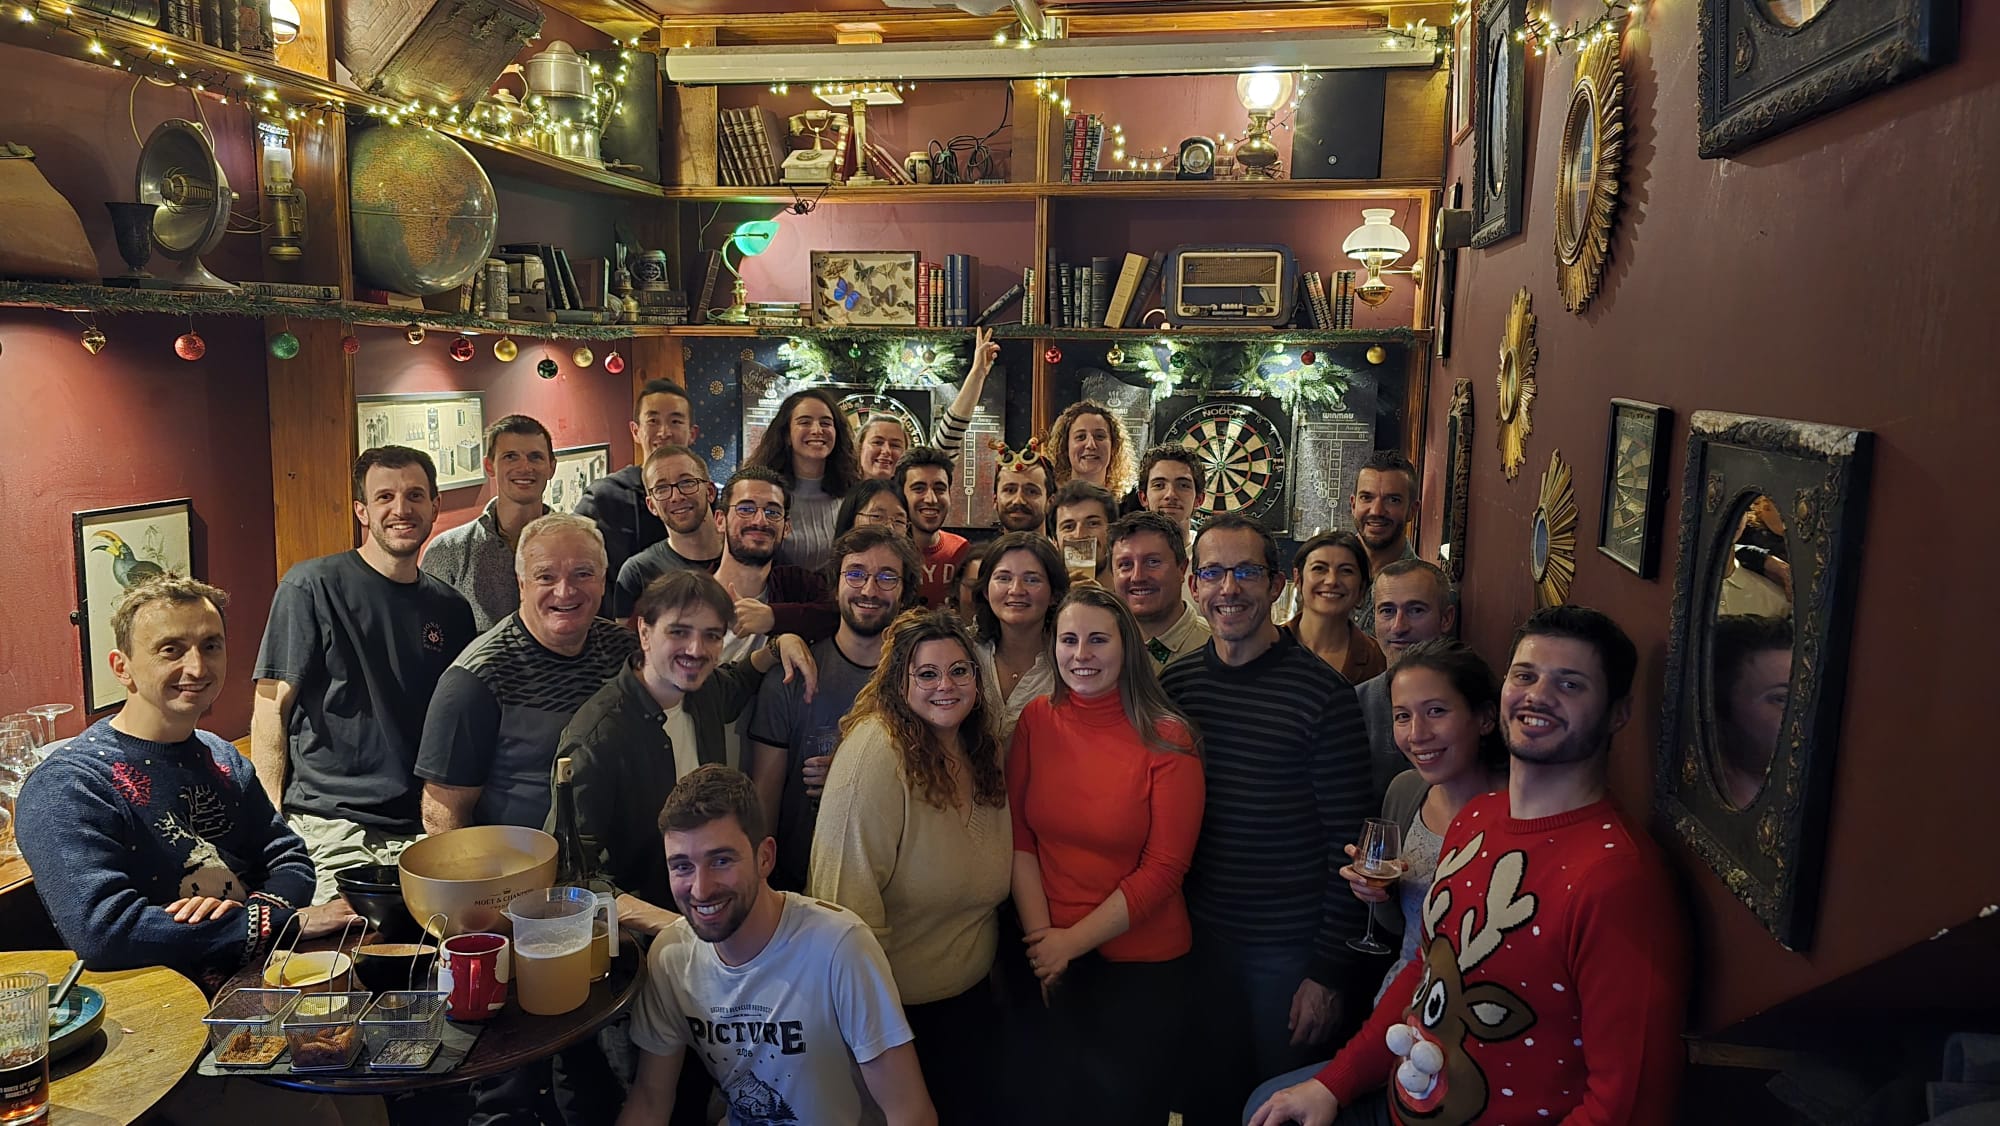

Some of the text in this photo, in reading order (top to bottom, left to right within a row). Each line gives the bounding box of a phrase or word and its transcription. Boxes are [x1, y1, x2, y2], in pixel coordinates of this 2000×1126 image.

[1322, 412, 1354, 420] WINMAU
[919, 563, 956, 586] YD
[685, 1015, 807, 1055] PICTURE
